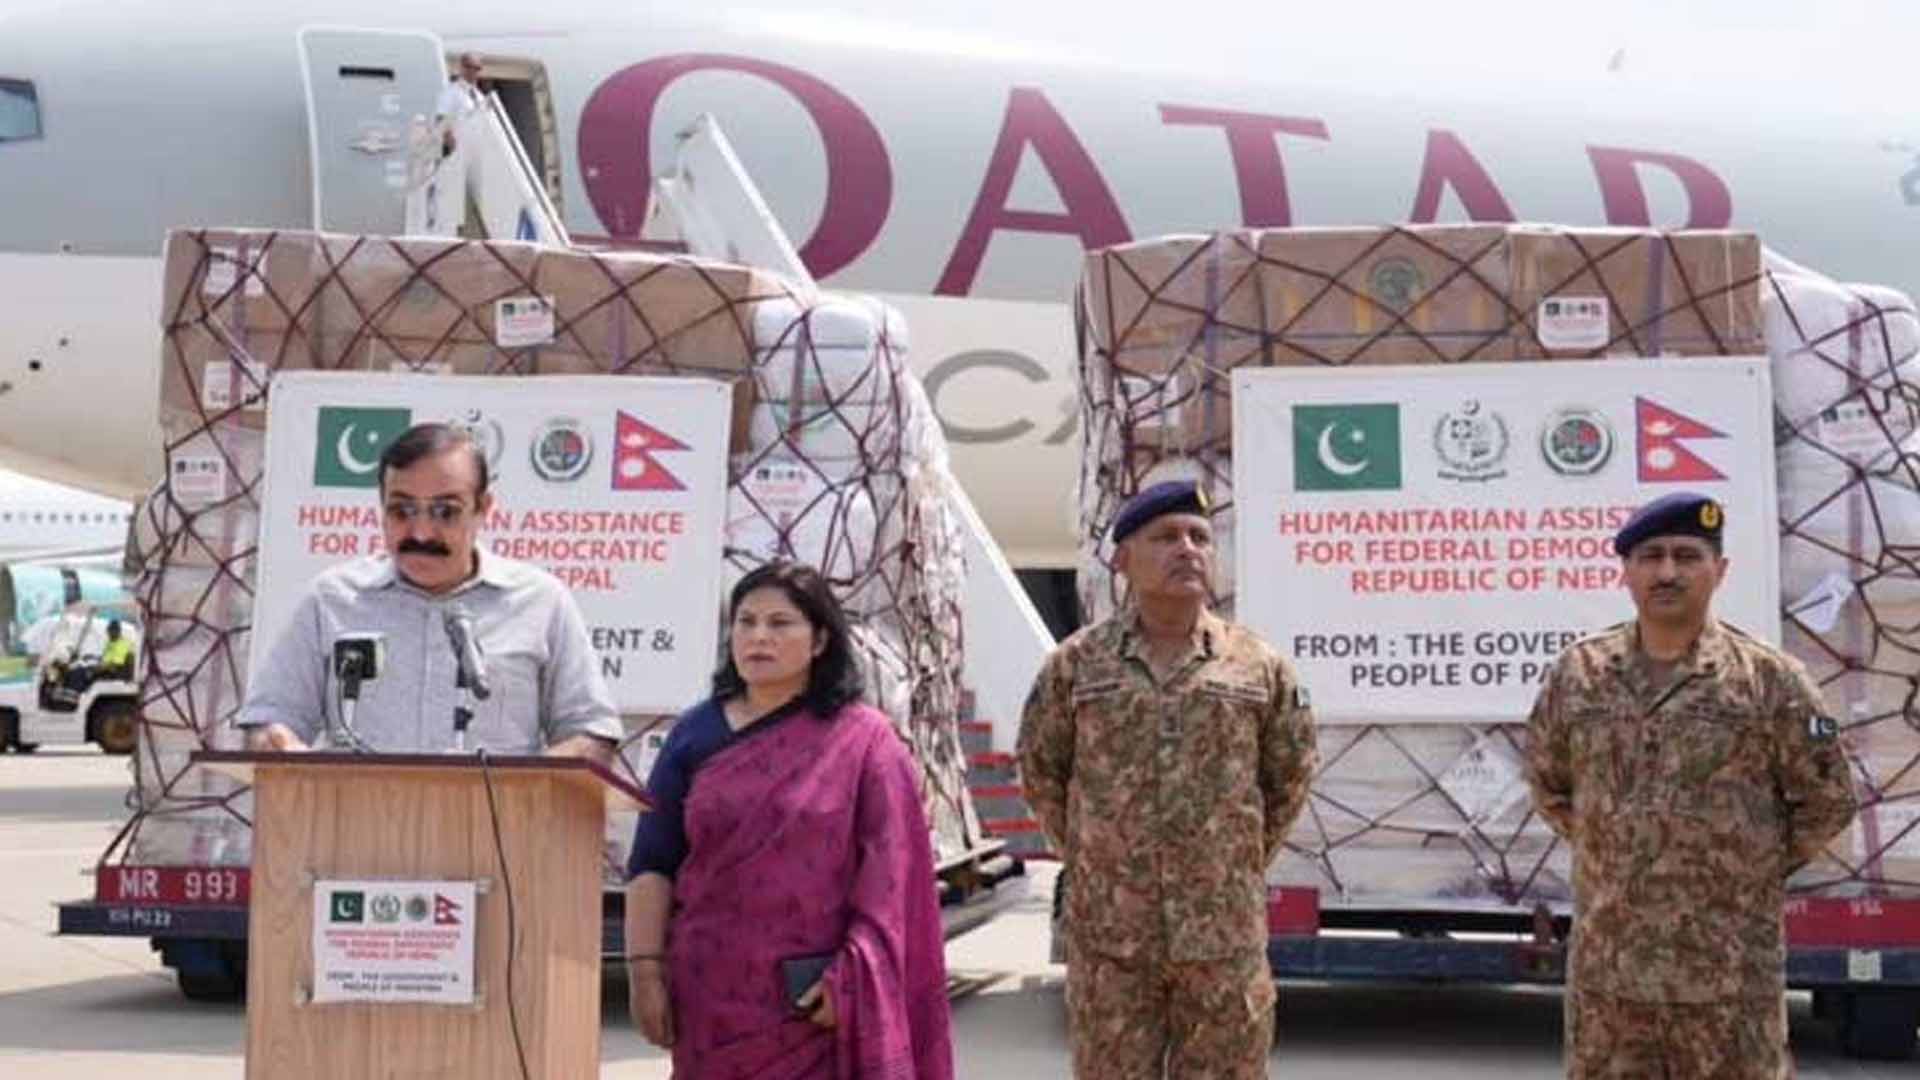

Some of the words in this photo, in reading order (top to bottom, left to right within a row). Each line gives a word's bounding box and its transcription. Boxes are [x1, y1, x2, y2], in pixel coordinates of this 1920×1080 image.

[520, 511, 684, 534] ASSISTANCE
[1279, 508, 1527, 535] HUMANITARIAN
[310, 533, 358, 554] FOR
[492, 538, 668, 562] DEMOCRATIC
[1296, 540, 1354, 565] FOR
[1365, 537, 1498, 563] FEDERAL
[1508, 537, 1617, 561] DEMOC
[1352, 567, 1497, 593] REPUBLIC
[1507, 567, 1547, 591] OF
[1558, 564, 1631, 589] NEPA
[652, 628, 675, 652] &
[1294, 633, 1378, 658] FROM
[1405, 632, 1465, 656] THE
[1474, 630, 1587, 656] GOVER
[1351, 663, 1461, 688] PEOPLE
[1470, 662, 1510, 686] OF
[119, 868, 159, 899] MR
